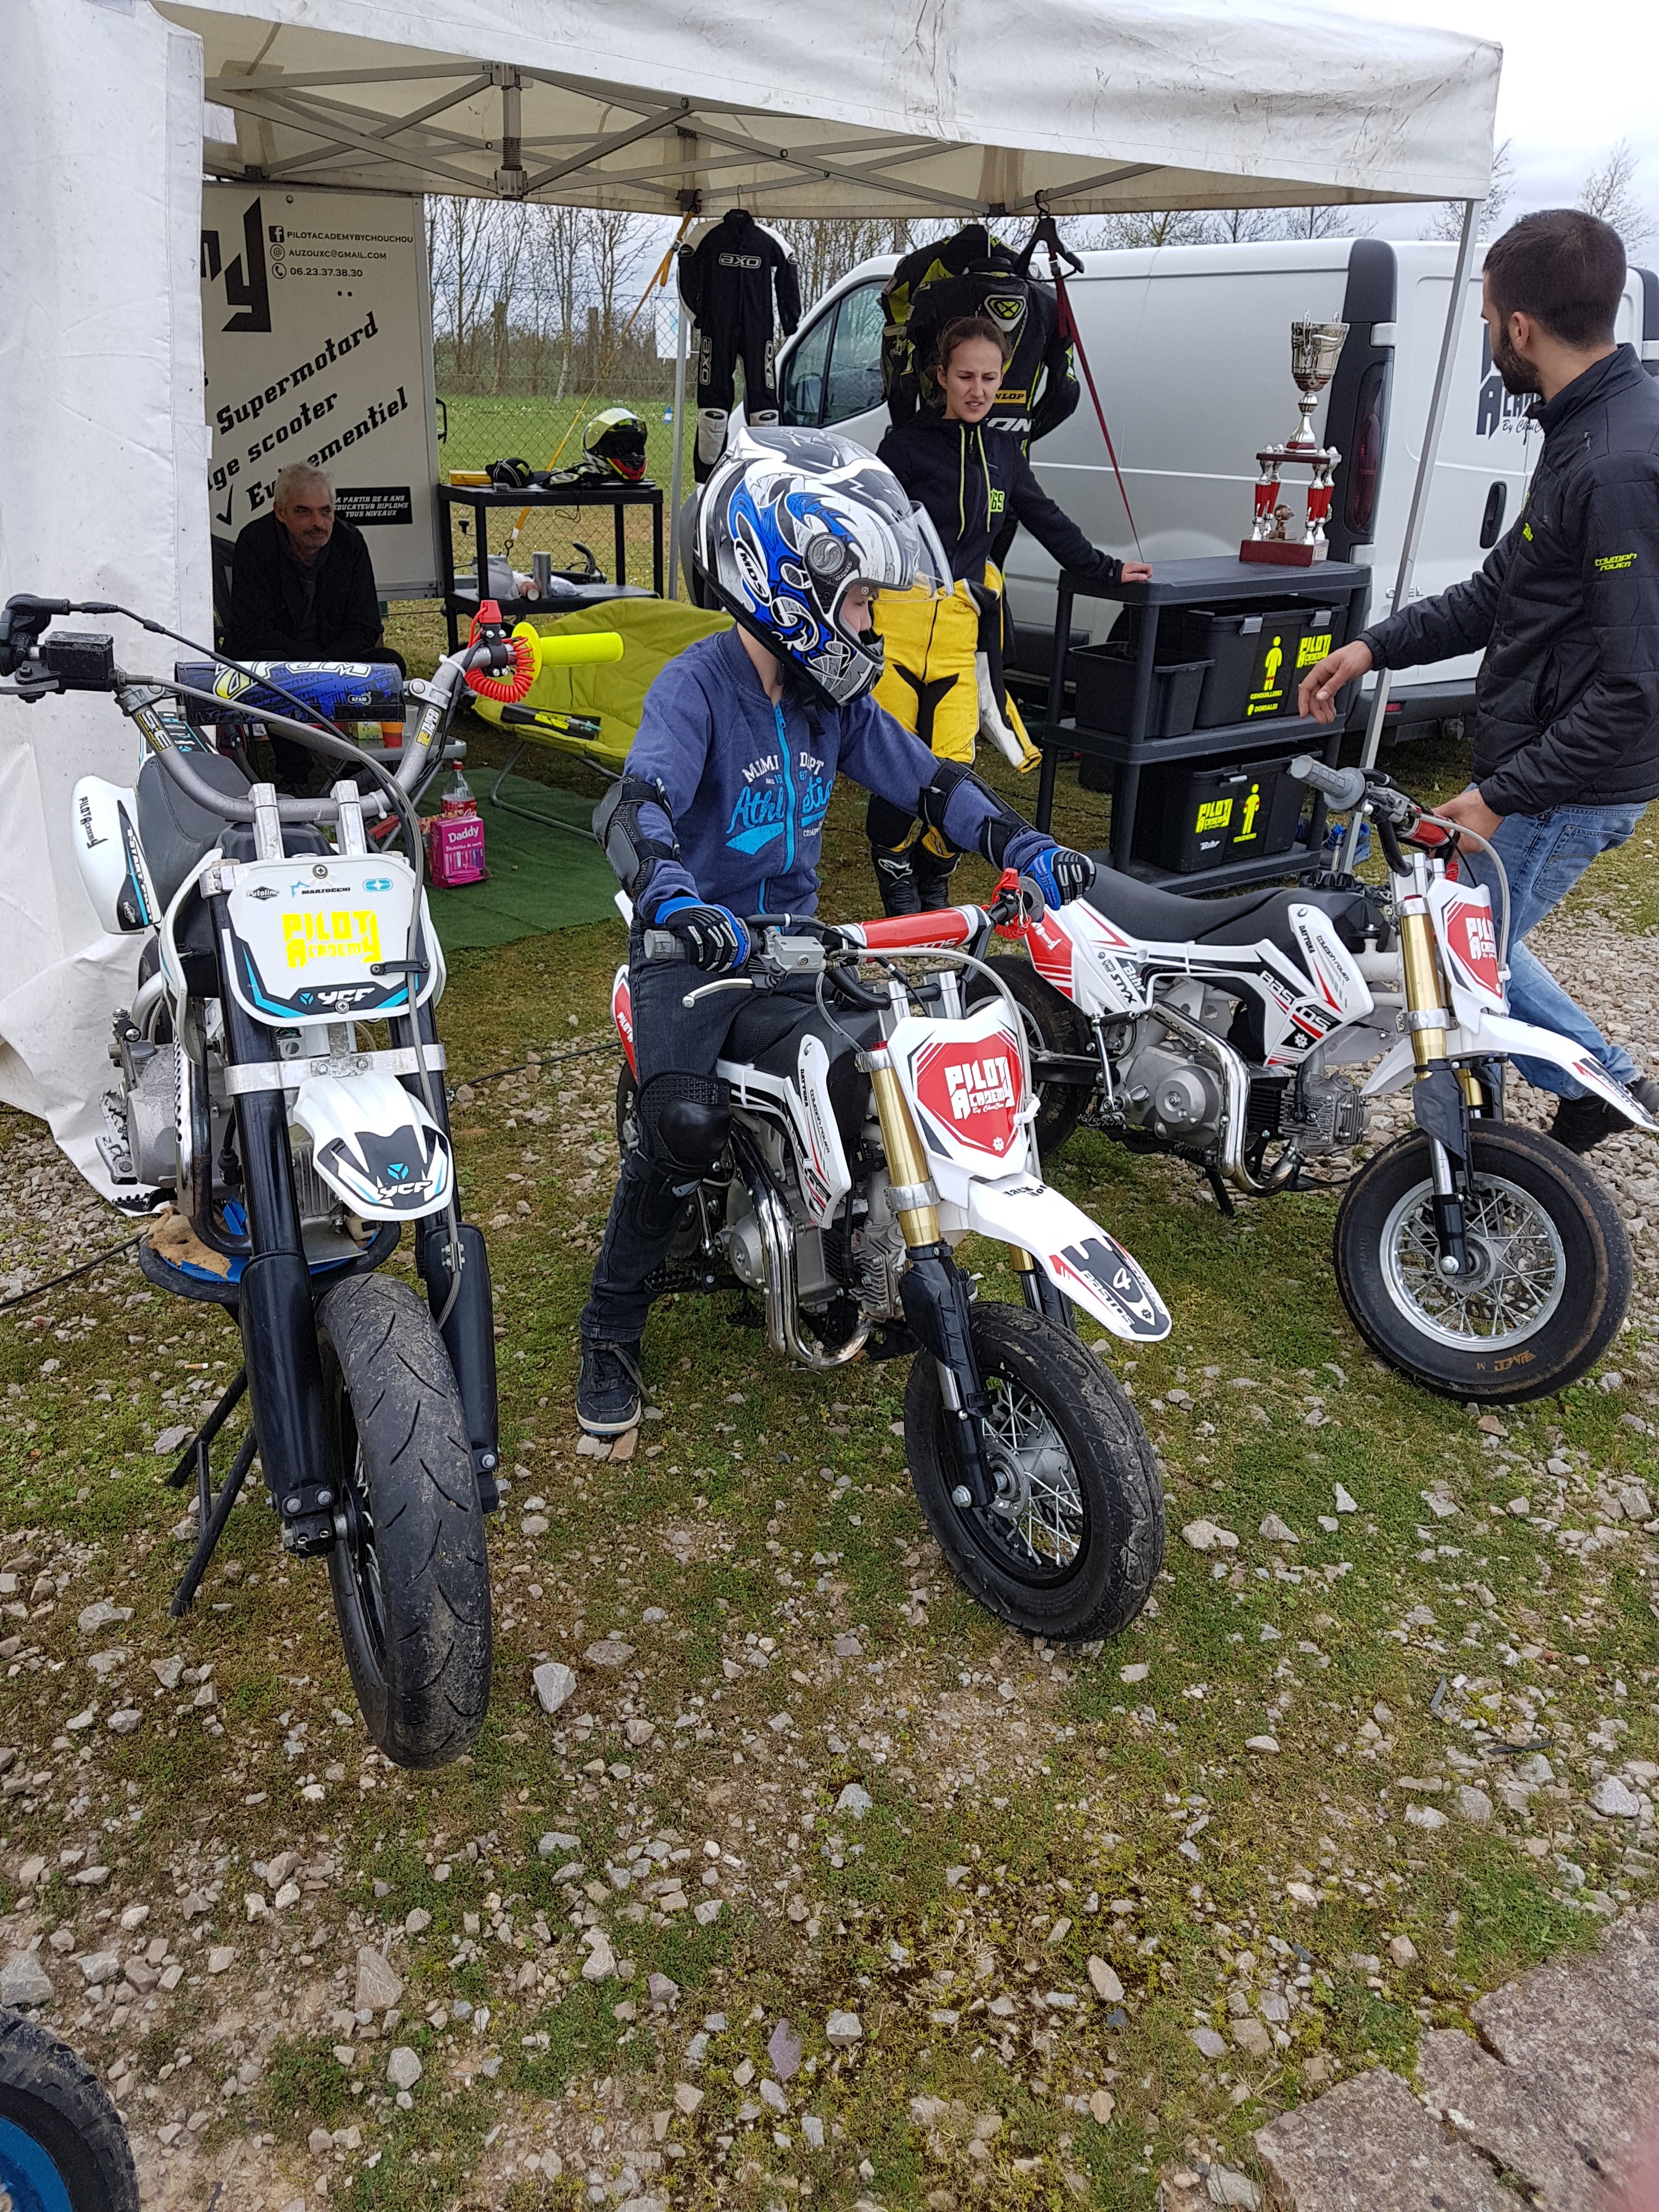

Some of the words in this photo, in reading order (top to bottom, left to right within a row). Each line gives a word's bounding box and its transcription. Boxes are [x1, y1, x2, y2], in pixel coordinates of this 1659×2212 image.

[287, 231, 413, 243] PILOTACADEMYBYCHOUCHOU
[289, 250, 387, 259] AUZOUXC@GMAIL.COM
[290, 267, 363, 277] 06.23.37.38.30
[216, 311, 378, 435] Supermotard
[248, 393, 337, 463] scooter
[740, 552, 765, 595] MDS
[1299, 634, 1331, 654] PILOT
[742, 755, 780, 783] MIMI
[1198, 798, 1233, 819] PILOT
[447, 825, 479, 843] Daddy
[246, 888, 280, 898] Putoline
[301, 887, 351, 895] MARZOCCHI
[281, 910, 376, 943] PILOT
[1299, 925, 1315, 953] DAYTONA
[1110, 974, 1137, 1003] STYX
[1123, 961, 1146, 991] Bihr
[800, 1069, 809, 1108] DAYTONA
[944, 1057, 1008, 1097] PILOT
[377, 1181, 432, 1200] YCF
